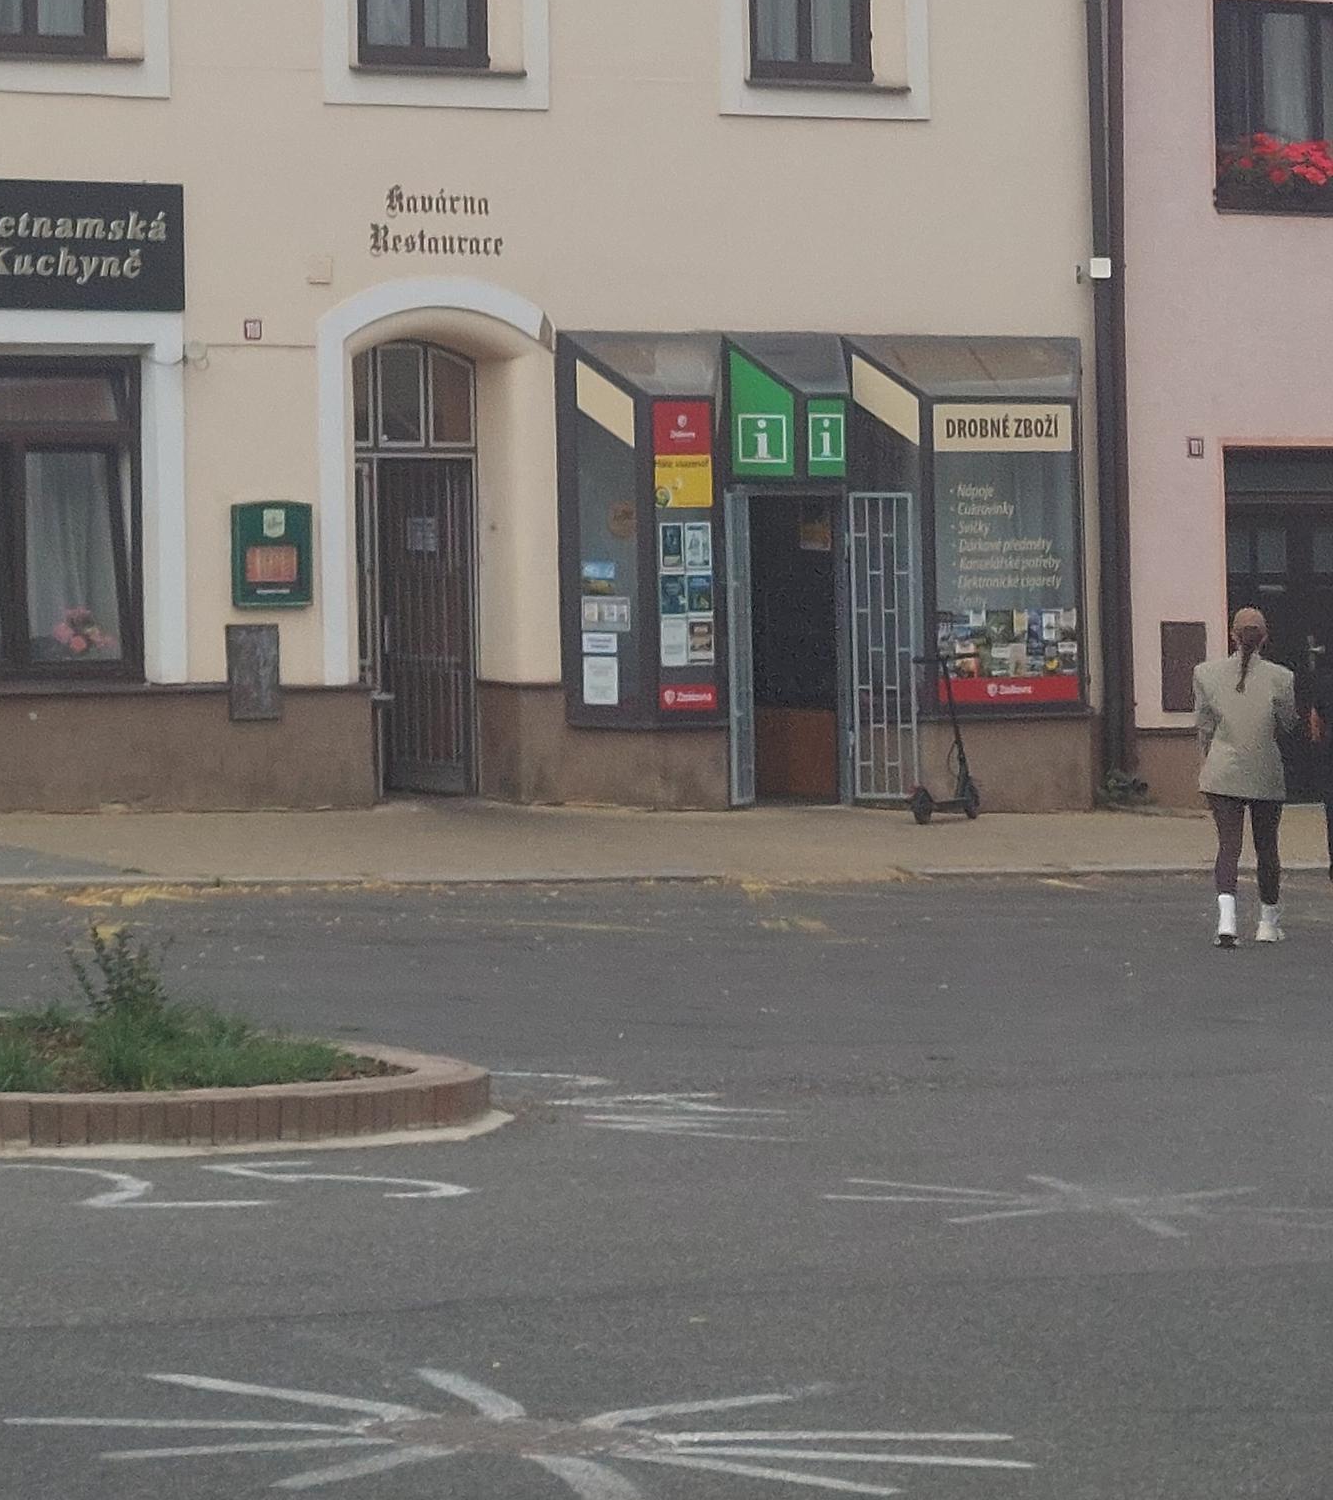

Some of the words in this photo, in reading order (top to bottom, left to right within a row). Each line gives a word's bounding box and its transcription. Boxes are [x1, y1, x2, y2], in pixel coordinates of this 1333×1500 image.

[386, 184, 490, 218] Kavárna
[369, 222, 504, 257] Restaurace
[946, 413, 1010, 439] DROBNÉ
[1014, 413, 1059, 439] ZBOŽÍ
